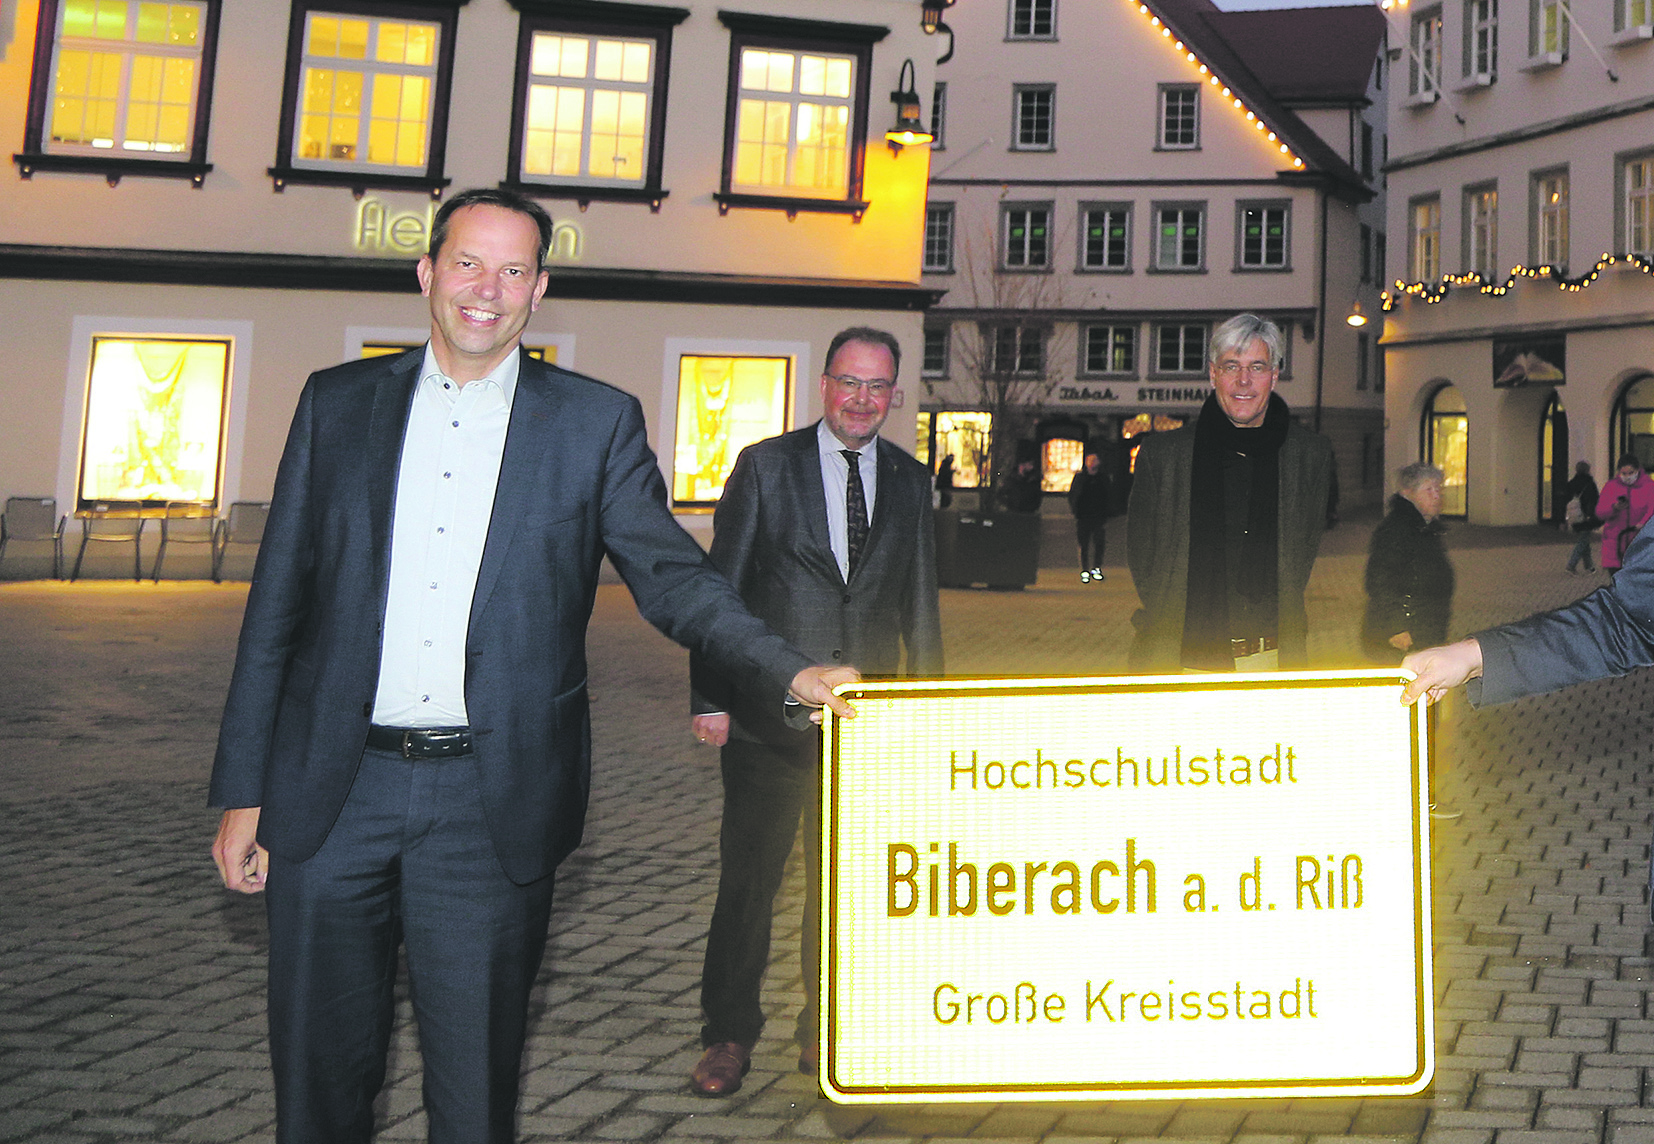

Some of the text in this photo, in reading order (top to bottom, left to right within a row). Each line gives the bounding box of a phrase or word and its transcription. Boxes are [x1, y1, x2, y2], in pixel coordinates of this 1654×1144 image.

[1137, 387, 1214, 401] STEINHAU
[949, 743, 1298, 791] Hochschulstadt
[886, 838, 1364, 918] Biberach a. d. Riß
[932, 978, 1318, 1025] Große Kreisstadt
